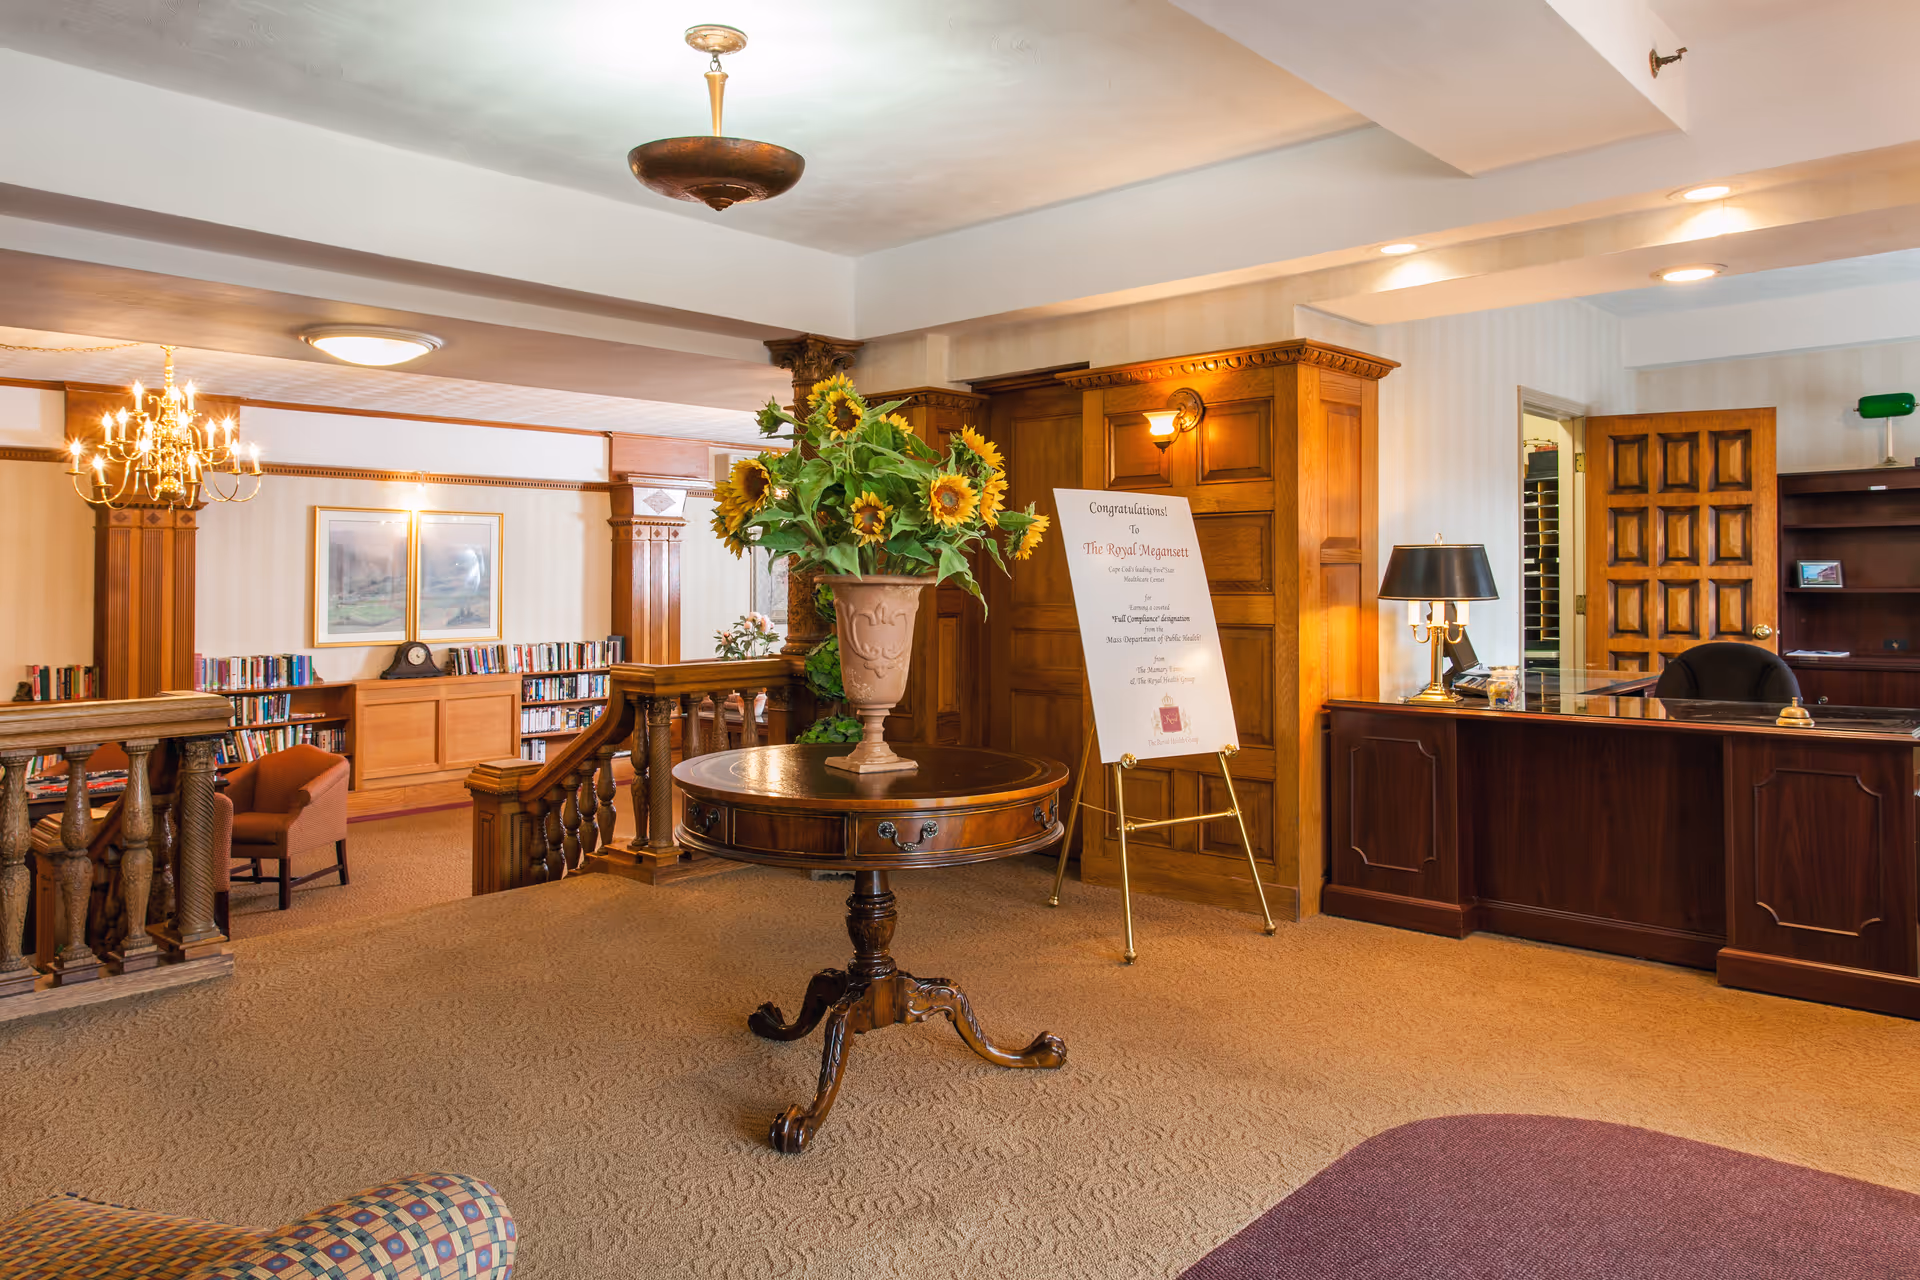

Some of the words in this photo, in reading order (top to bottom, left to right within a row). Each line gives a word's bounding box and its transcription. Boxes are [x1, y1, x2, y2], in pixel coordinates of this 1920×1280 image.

[1089, 502, 1168, 517] Congratulations!
[1129, 524, 1139, 534] To
[1083, 541, 1103, 555] The
[1107, 542, 1136, 559] Royal
[1139, 544, 1189, 560] Megansett
[1108, 566, 1120, 574] Cape
[1135, 566, 1152, 574] leading
[1144, 594, 1152, 602] for
[1127, 614, 1160, 624] Compliance"
[1161, 614, 1190, 624] designation
[1144, 626, 1155, 634] from
[1123, 636, 1156, 645] Department
[1157, 636, 1164, 644] of
[1153, 655, 1164, 664] from
[1147, 677, 1162, 685] Royal
